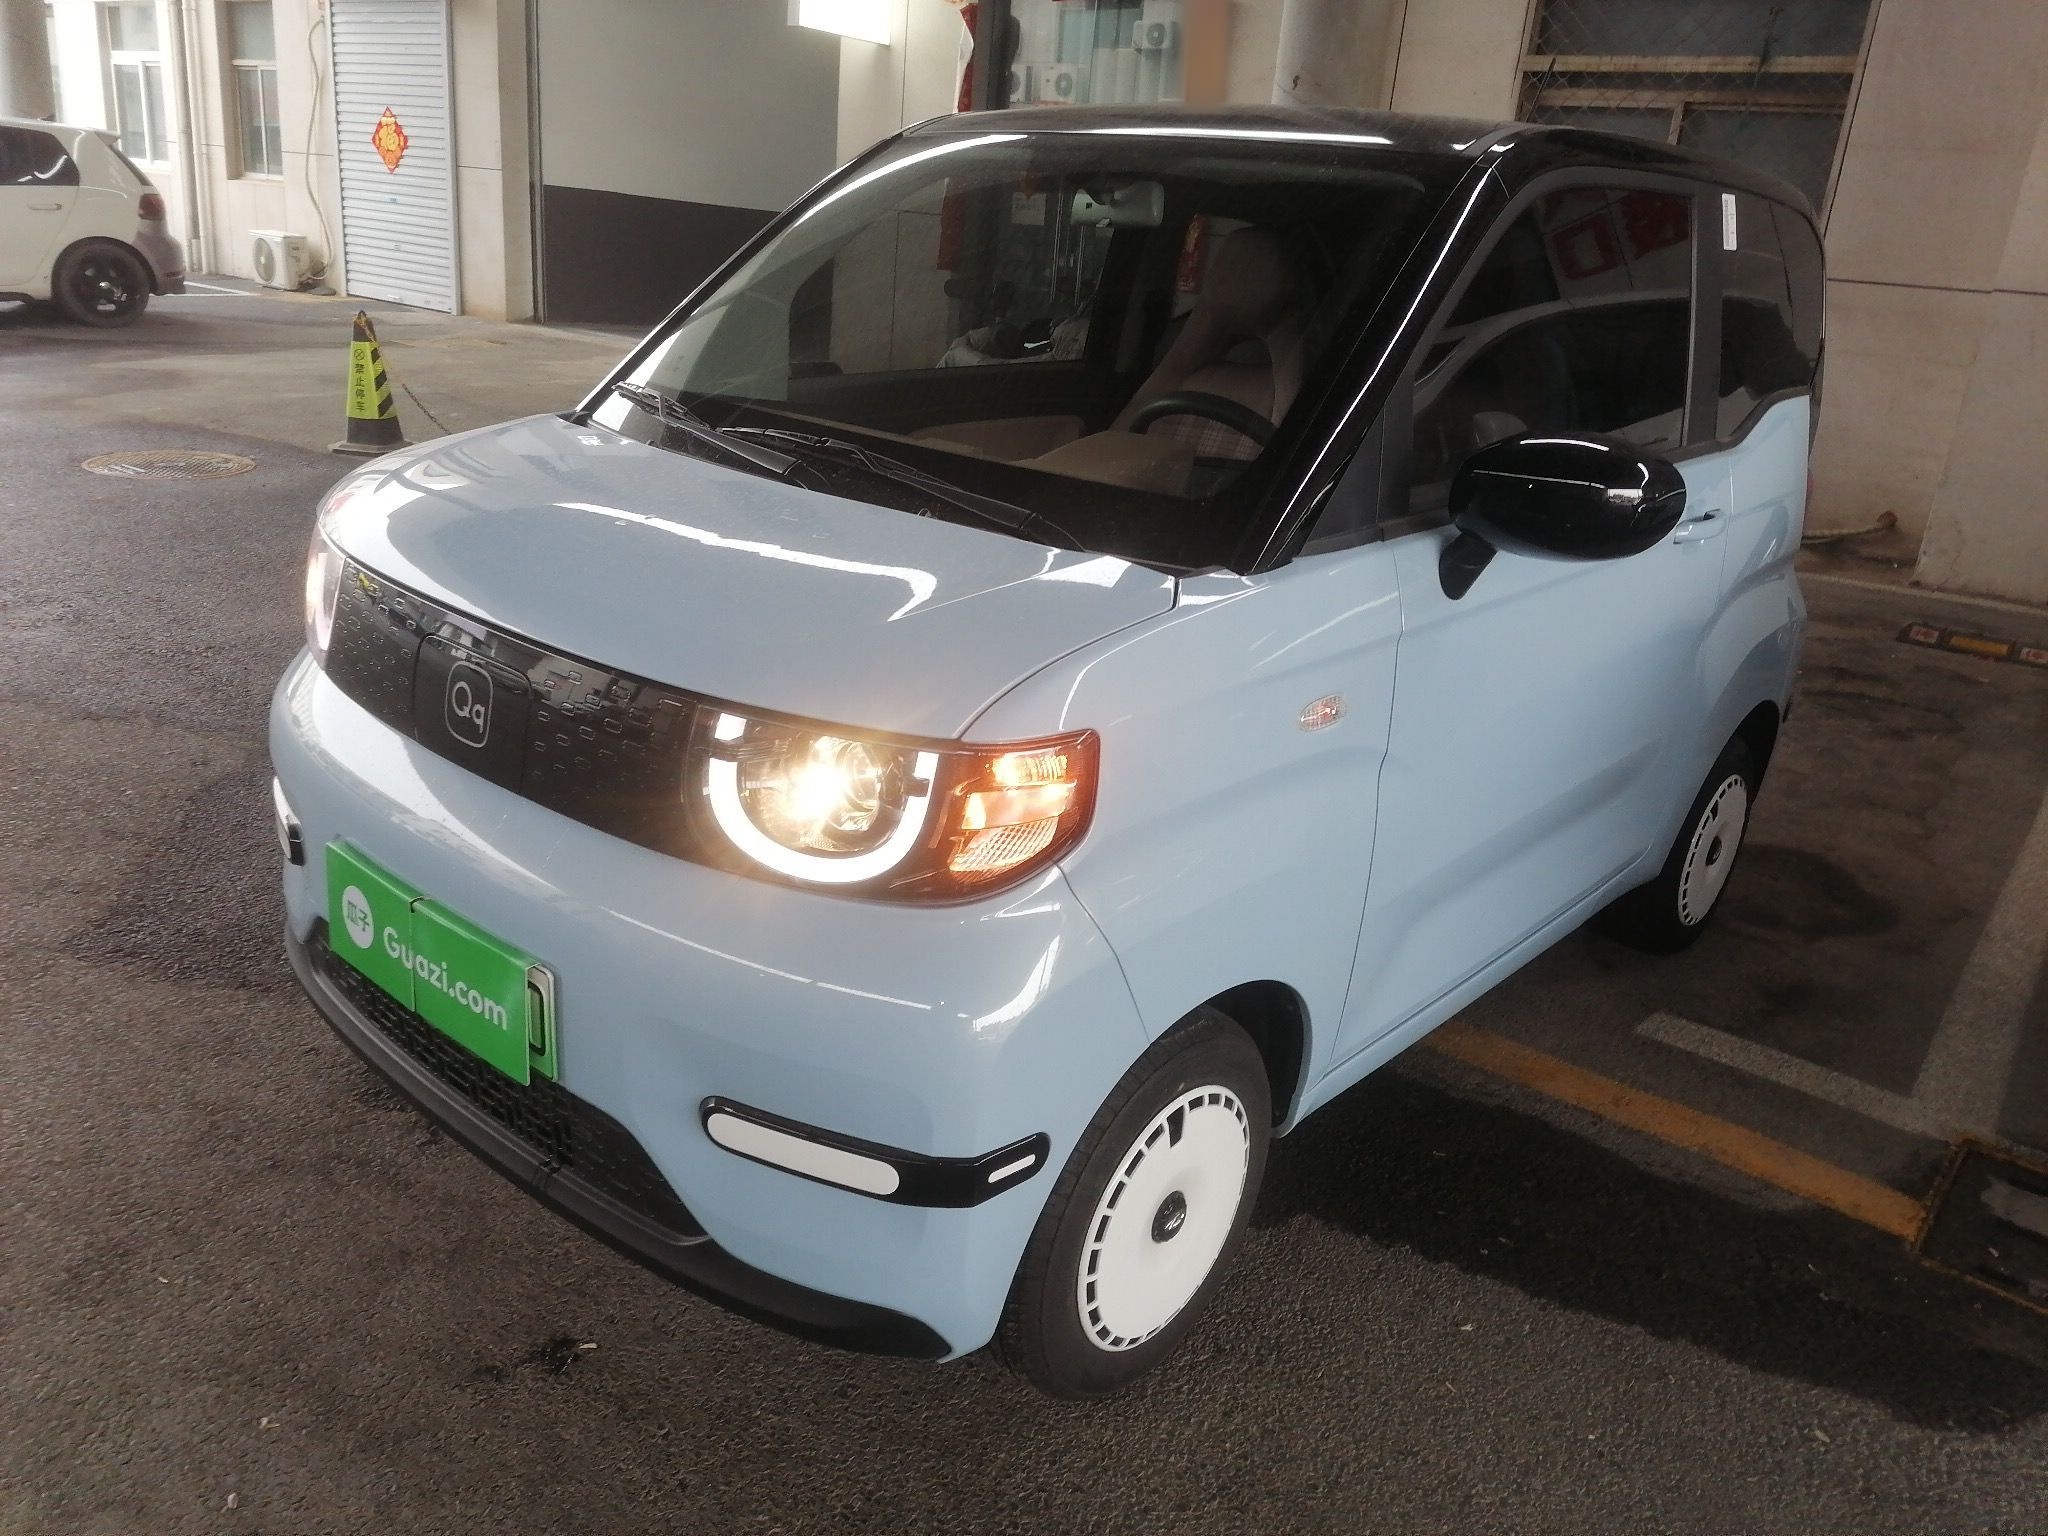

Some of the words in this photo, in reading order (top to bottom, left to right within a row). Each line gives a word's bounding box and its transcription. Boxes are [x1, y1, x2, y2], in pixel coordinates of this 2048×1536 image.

[354, 363, 365, 412] 禁止停车
[346, 899, 370, 932] 瓜子
[383, 926, 508, 1031] Guazi.com
